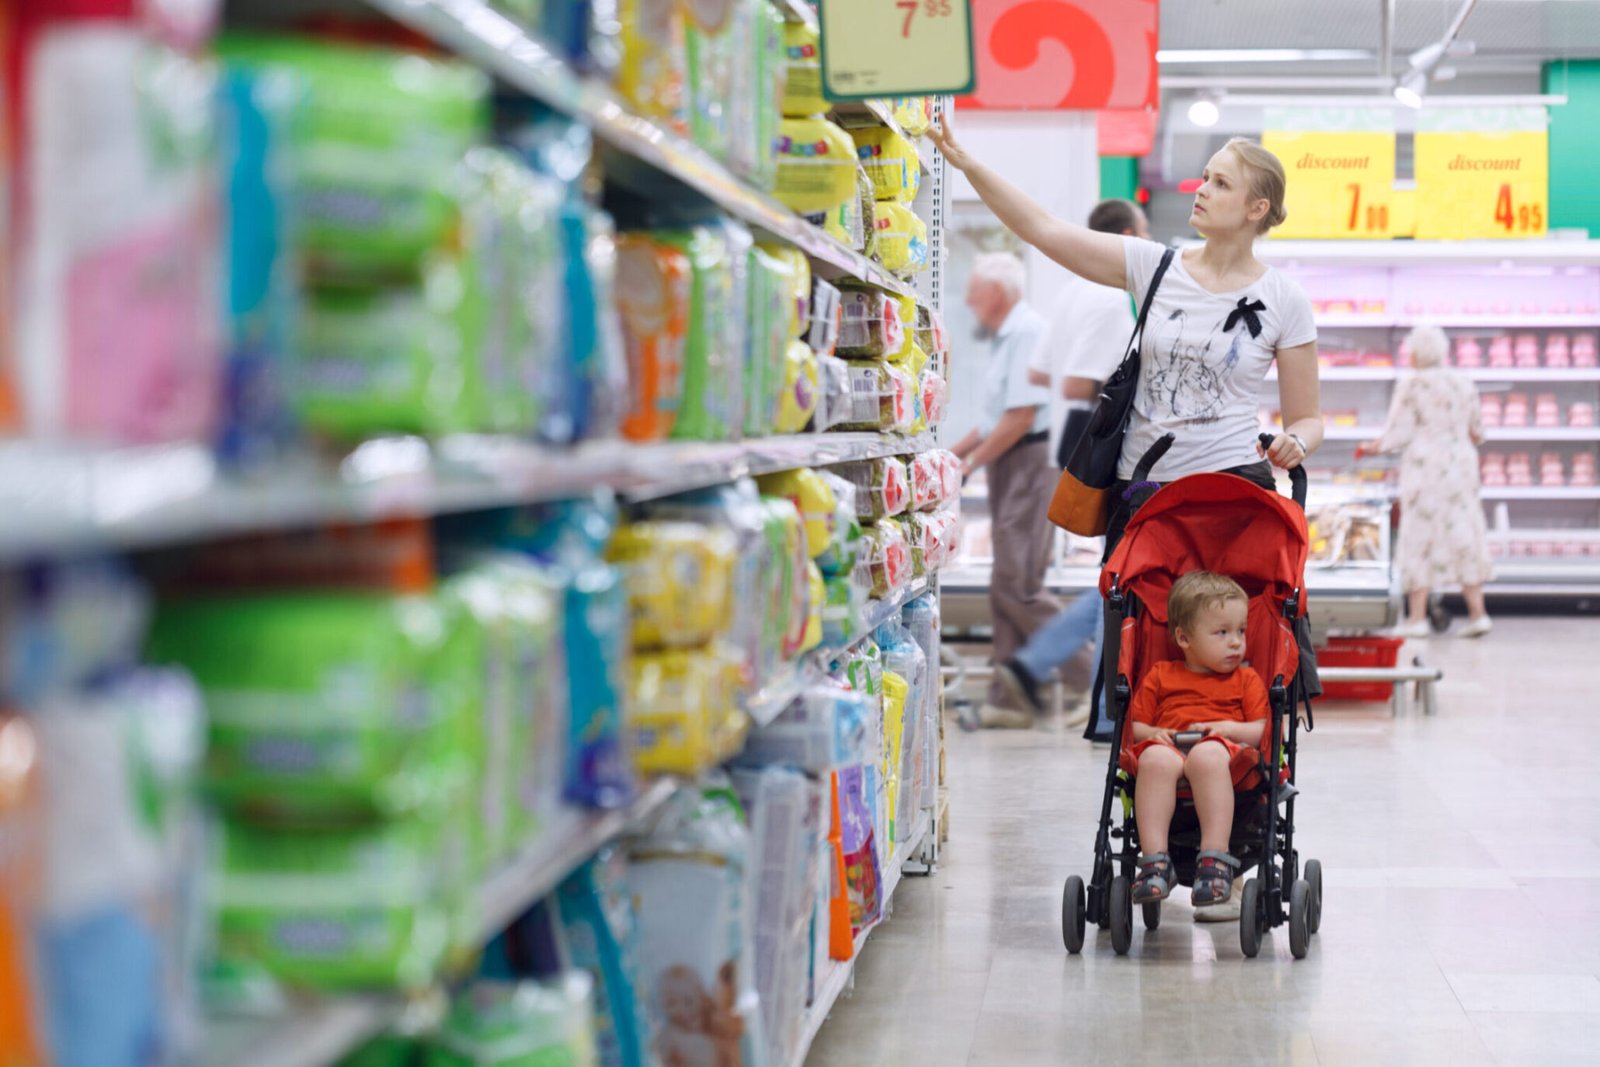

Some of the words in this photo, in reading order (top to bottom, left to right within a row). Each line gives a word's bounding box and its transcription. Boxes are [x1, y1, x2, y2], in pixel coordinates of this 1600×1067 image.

[896, 1, 918, 38] 7
[1296, 152, 1369, 169] discount
[1448, 154, 1521, 171] discount
[1495, 183, 1513, 230] 4
[1519, 205, 1542, 231] 95
